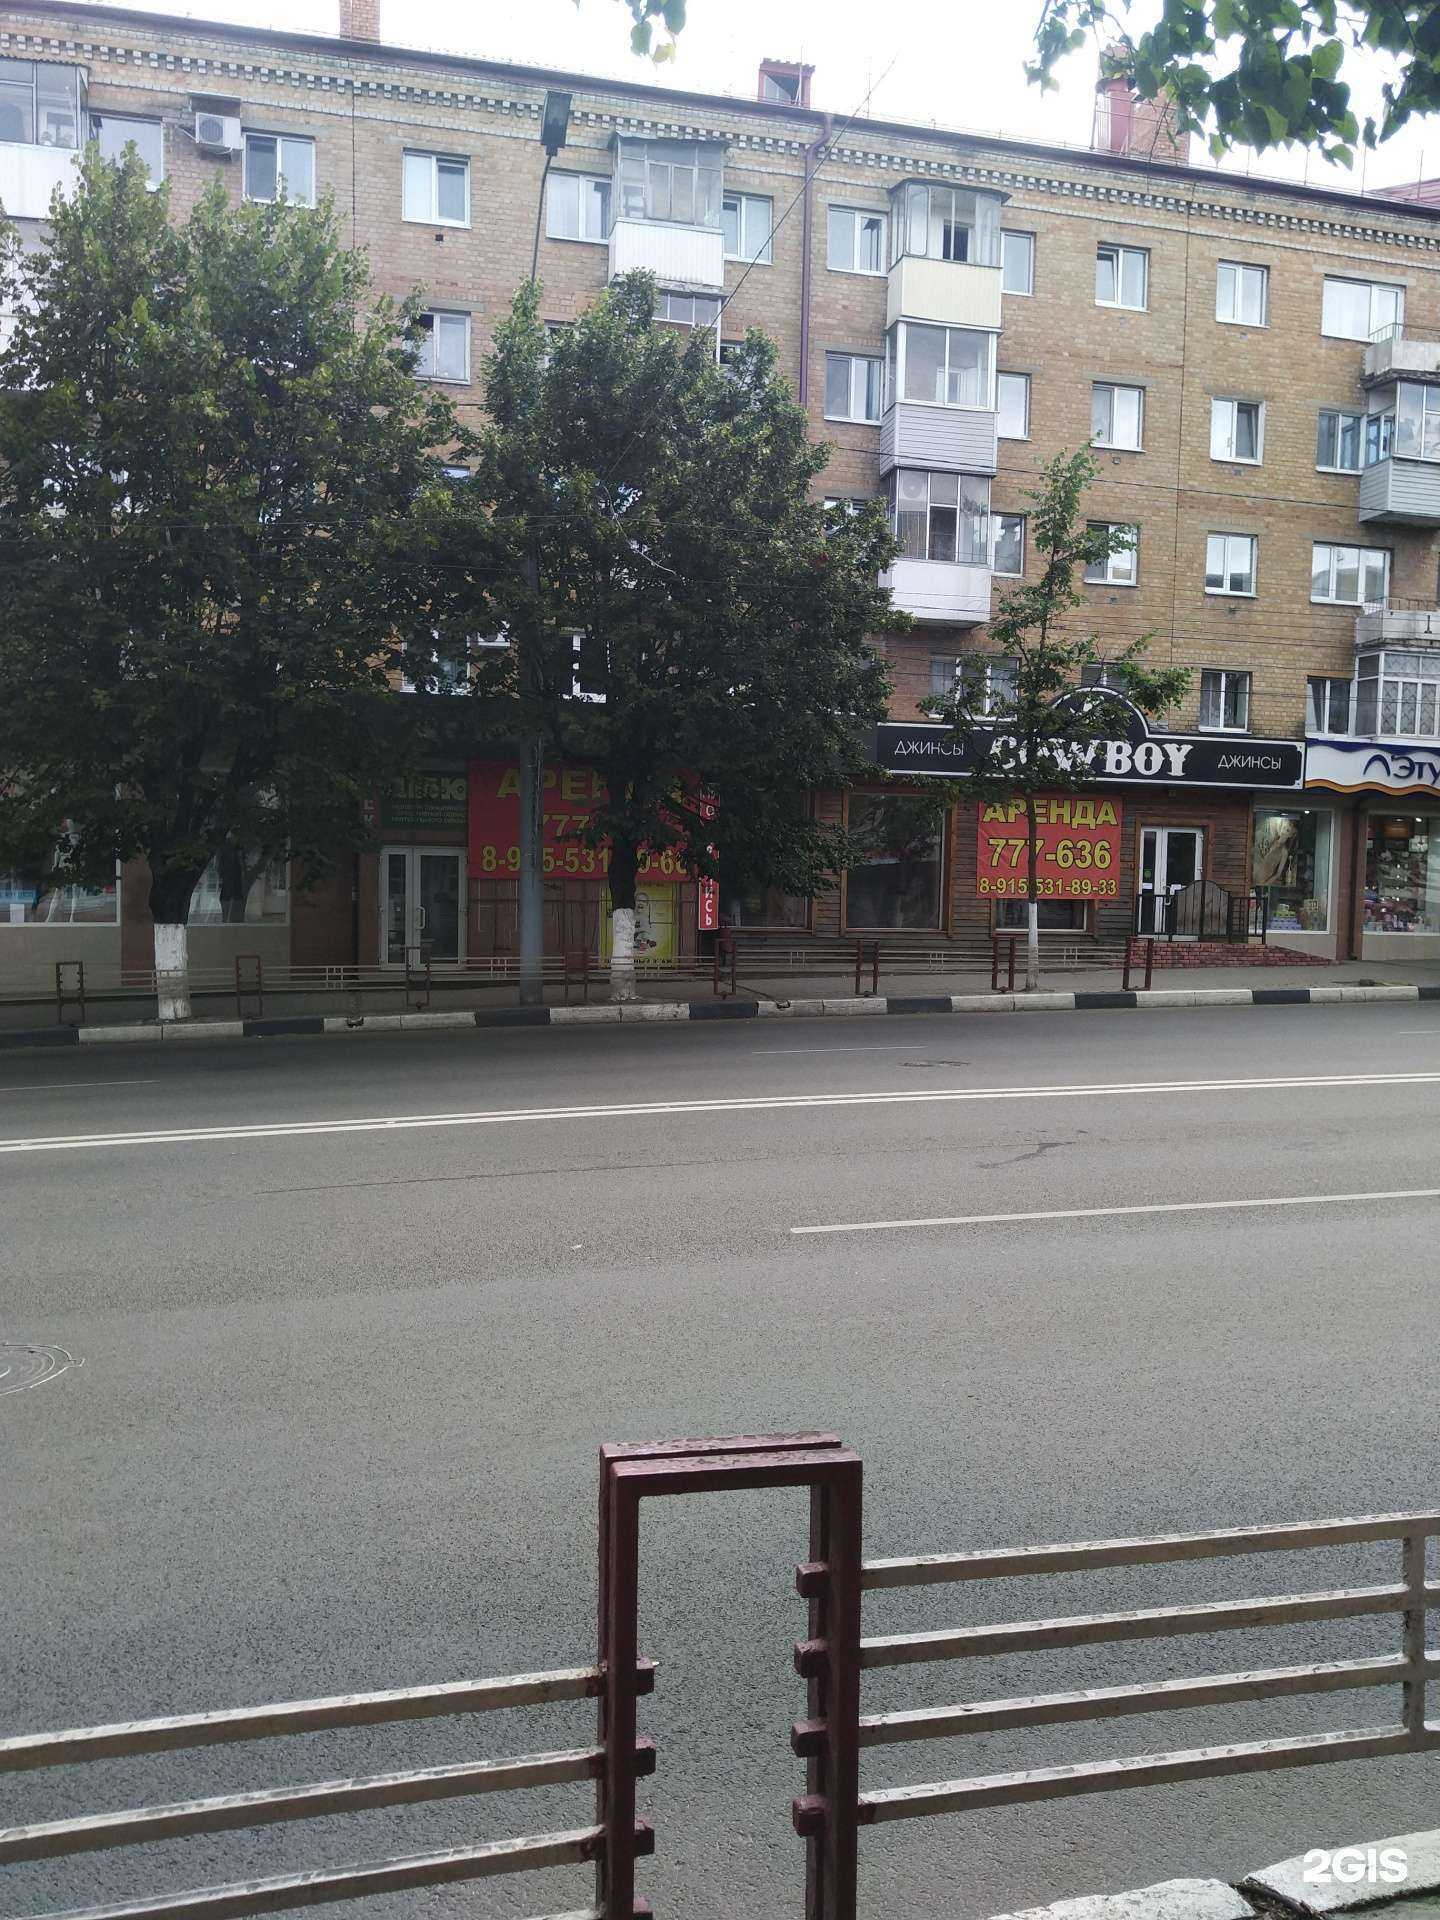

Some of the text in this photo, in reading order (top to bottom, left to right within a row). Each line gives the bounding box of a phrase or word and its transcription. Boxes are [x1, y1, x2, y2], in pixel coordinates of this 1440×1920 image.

[894, 740, 964, 756] ДЖИНСЫ
[988, 735, 1194, 777] CWBOY
[1217, 754, 1282, 770] ДЖИНСЫ
[982, 798, 1118, 830] АРЕНДА
[979, 877, 1117, 896] 8-915531-89-33
